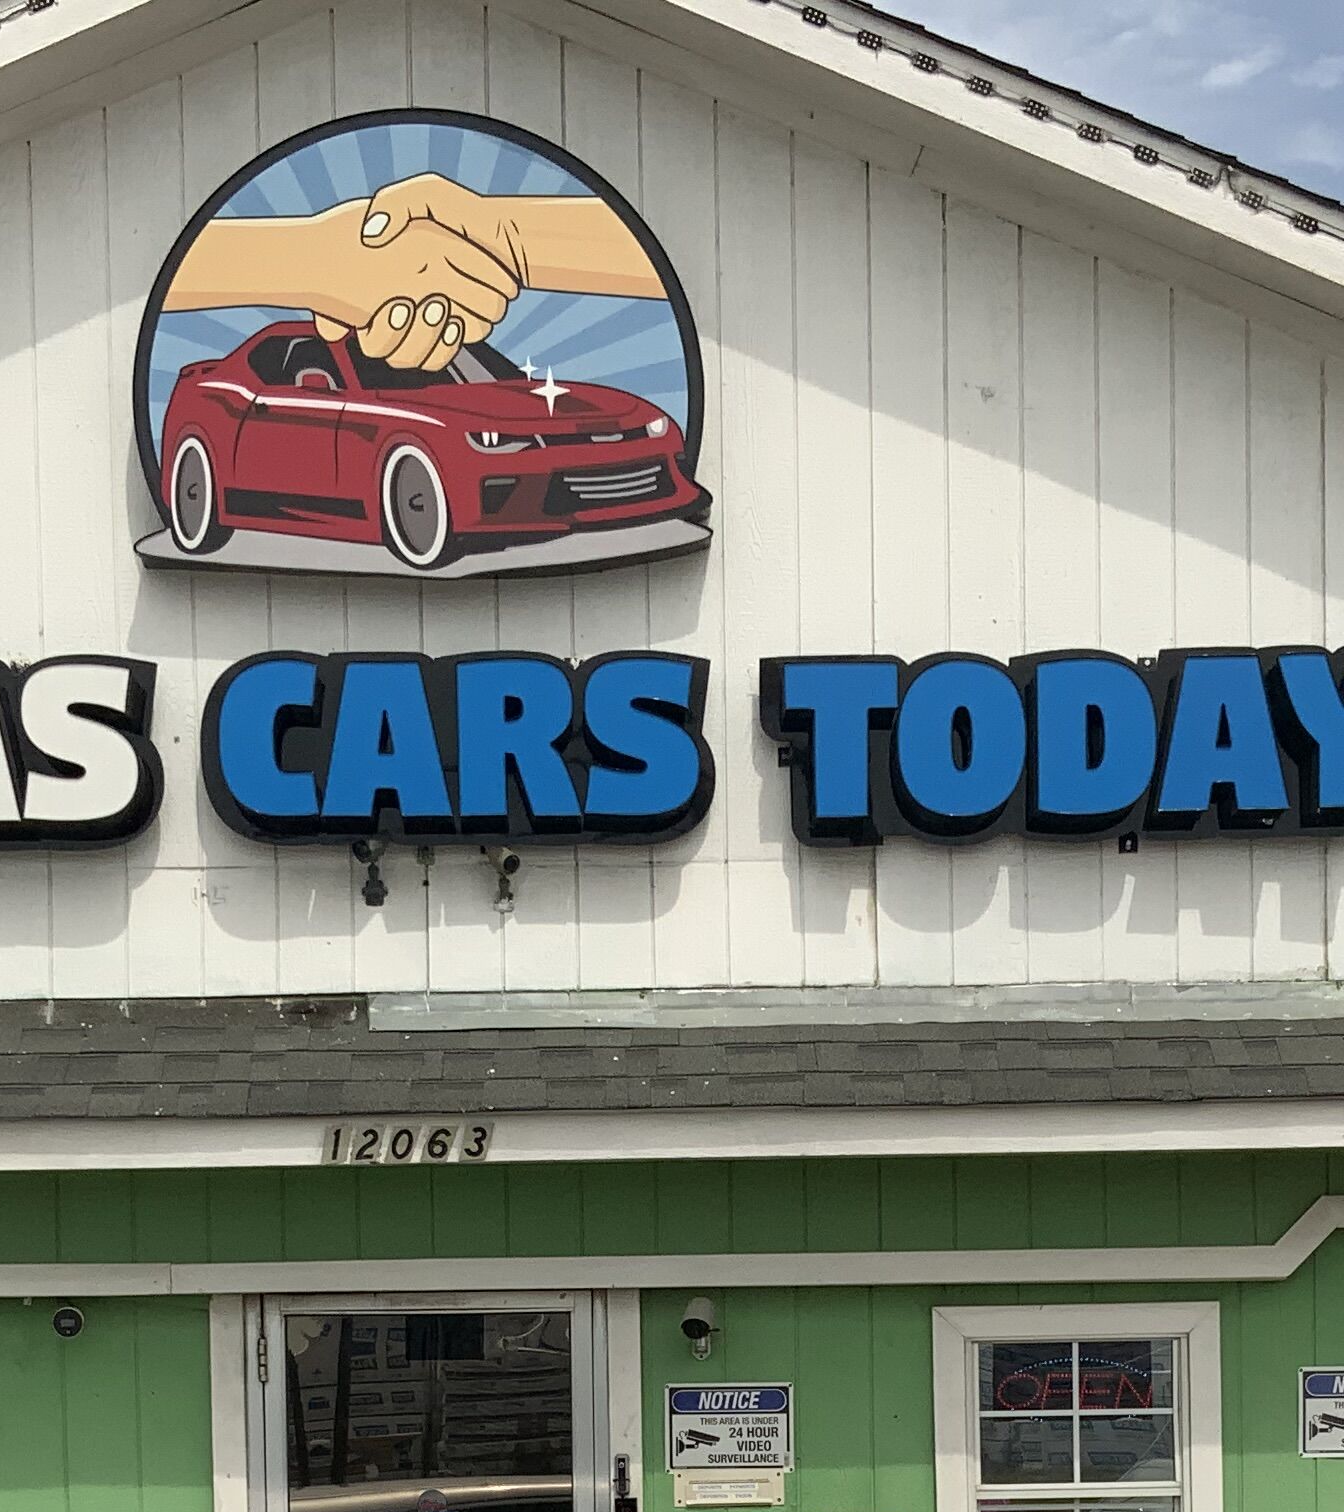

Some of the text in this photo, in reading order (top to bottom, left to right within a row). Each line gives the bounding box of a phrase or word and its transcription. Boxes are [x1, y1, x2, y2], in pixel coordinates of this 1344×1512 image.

[219, 660, 699, 817] CARS
[332, 1126, 487, 1161] 12063
[997, 1371, 1153, 1410] OPEN
[698, 1391, 761, 1410] NOTICE
[700, 1416, 779, 1425] THIS AREA IS UNDER
[729, 1427, 779, 1438] 24 HOUR
[737, 1441, 772, 1452] VIDEO
[708, 1453, 779, 1464] SURVEILLANCE
